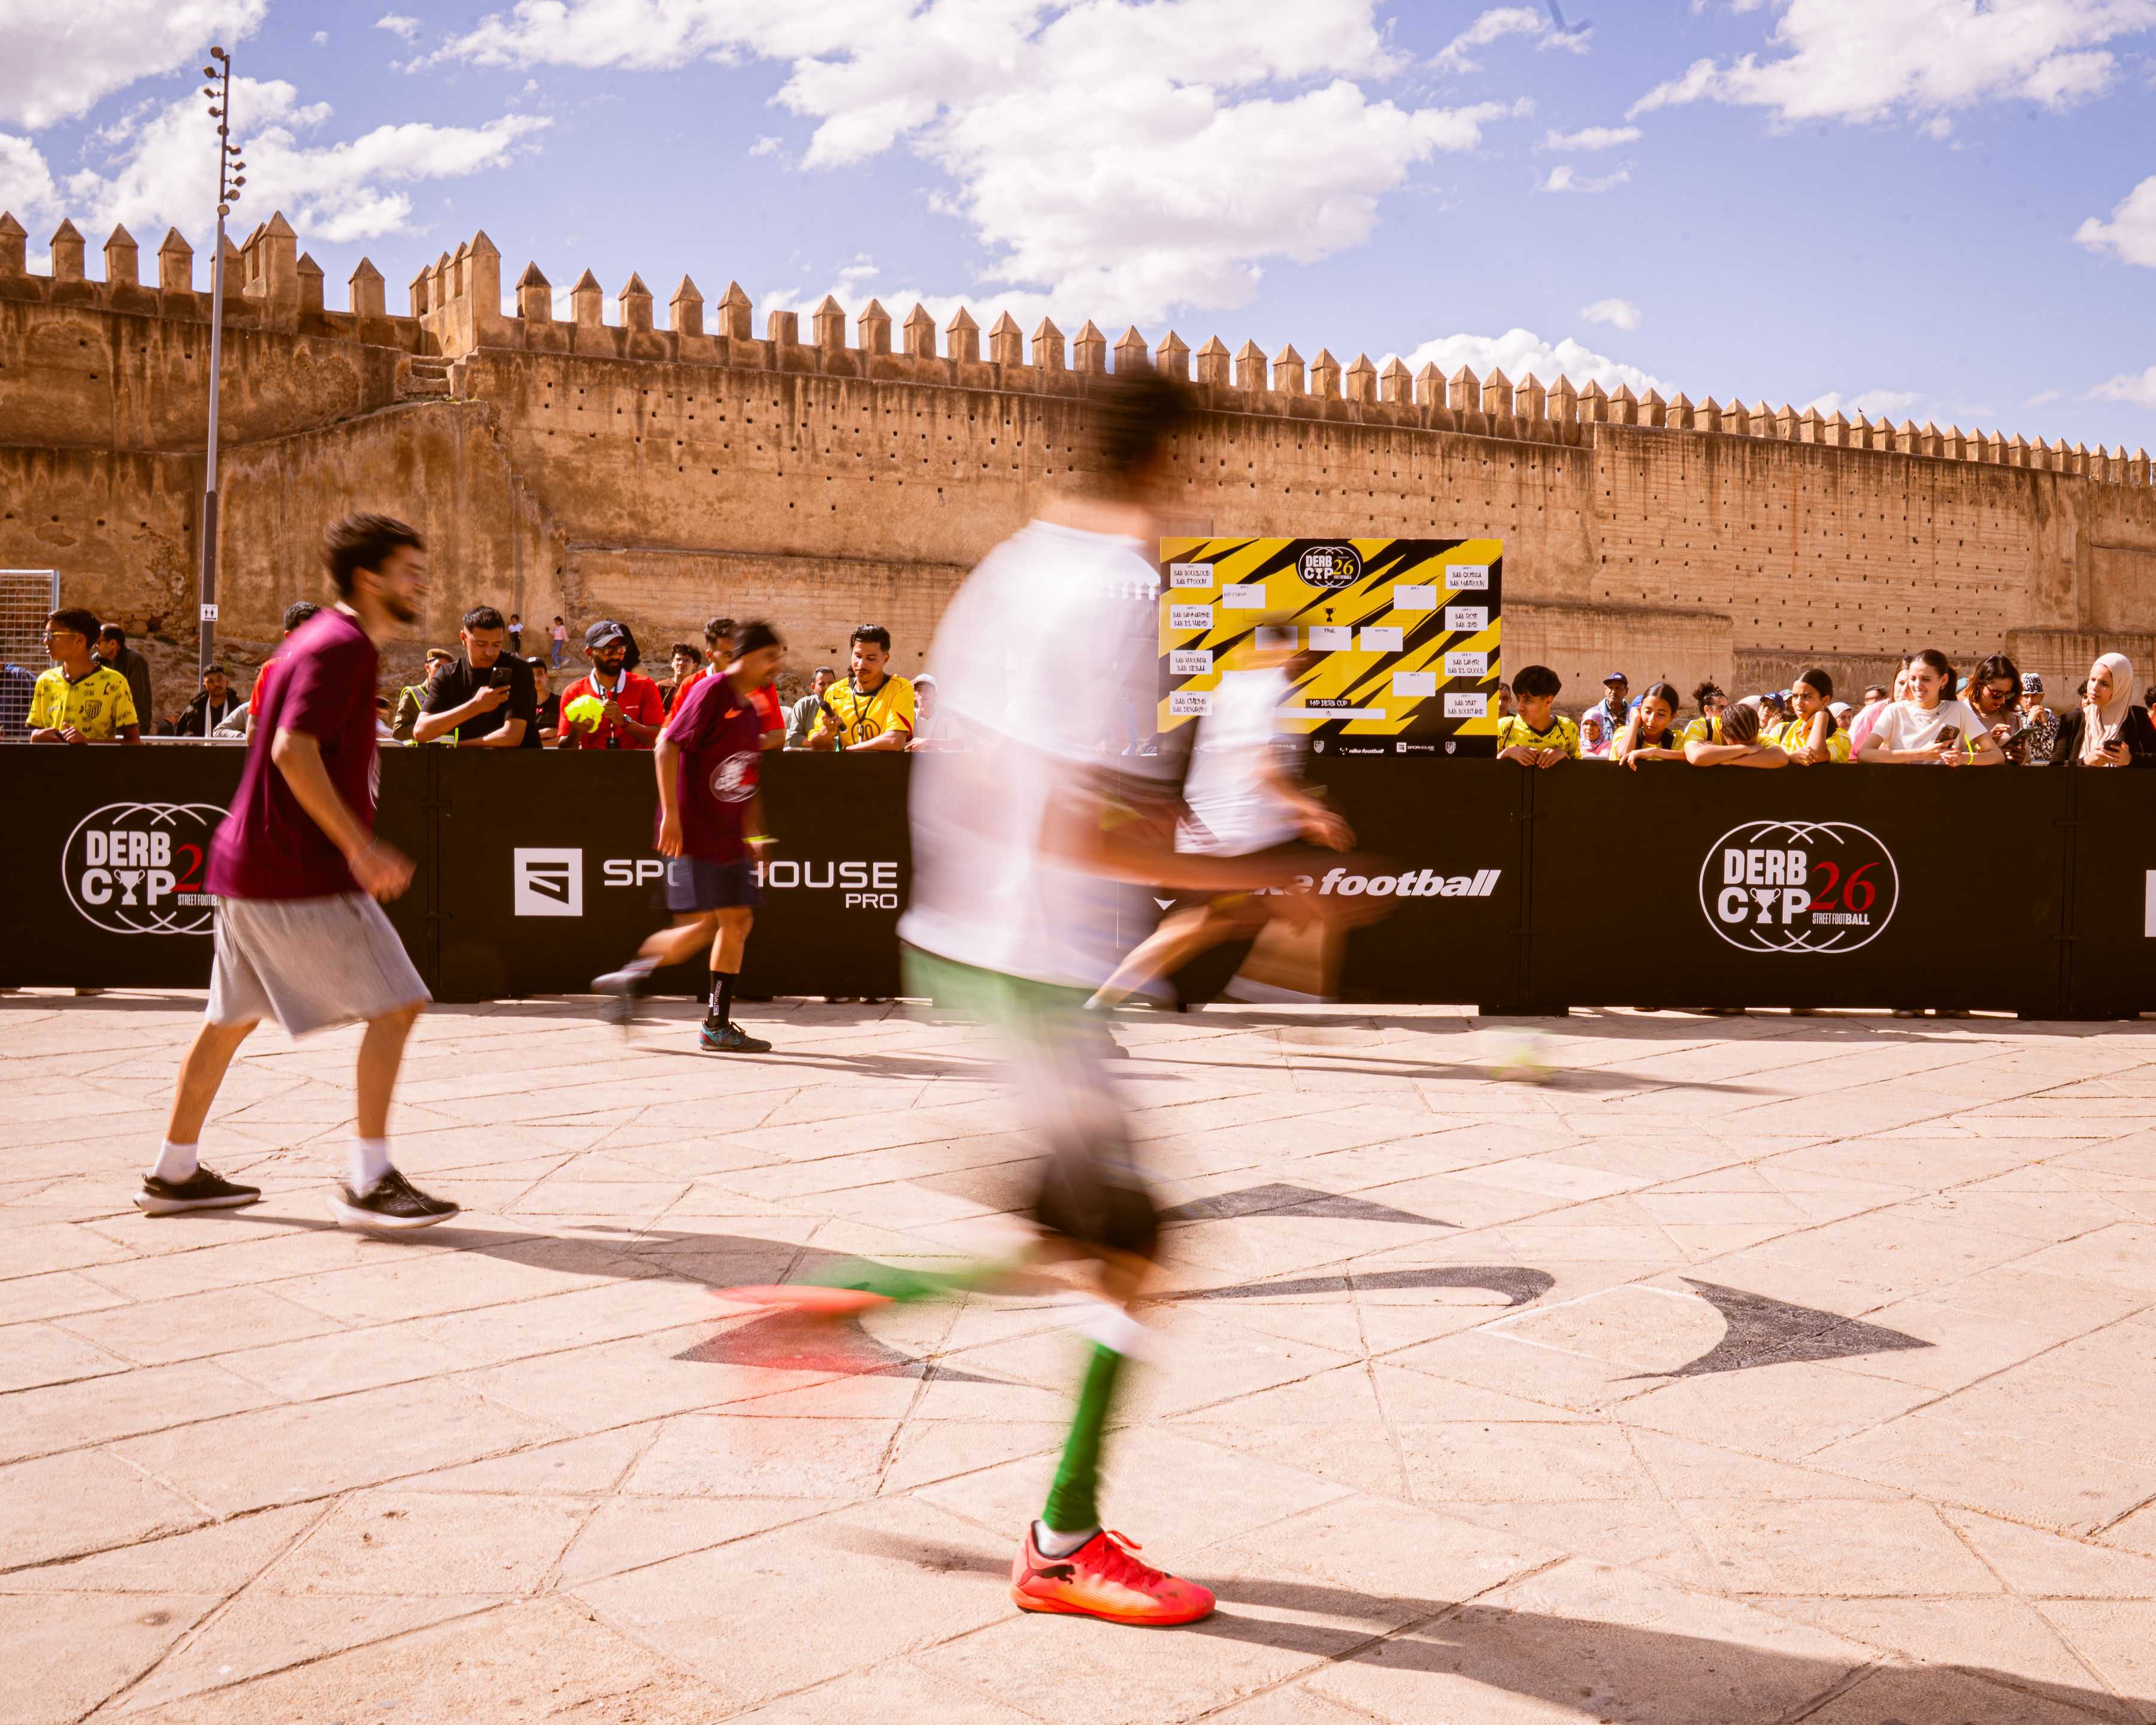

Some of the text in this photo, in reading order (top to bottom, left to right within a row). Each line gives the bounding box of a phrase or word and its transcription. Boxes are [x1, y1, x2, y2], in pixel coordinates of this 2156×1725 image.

[1306, 555, 1332, 567] DERB
[1333, 559, 1354, 575] 26
[86, 830, 171, 867] DERB
[169, 843, 203, 892] 2
[1724, 849, 1807, 885] DERB
[1319, 868, 1501, 897] football
[1805, 861, 1881, 912] 26
[846, 893, 898, 909] PRO
[1812, 913, 1870, 925] STREET FOOTBALL
